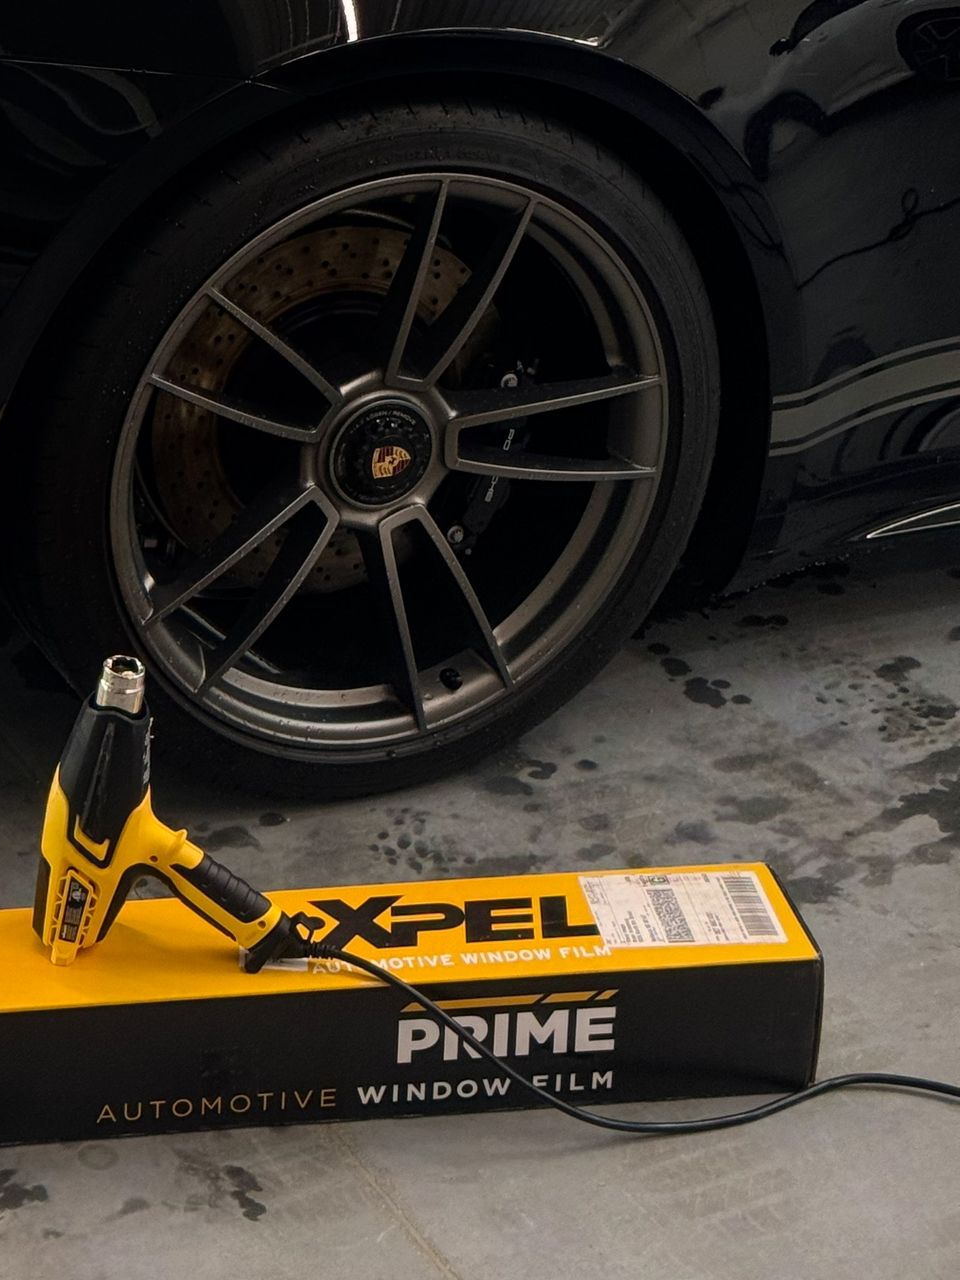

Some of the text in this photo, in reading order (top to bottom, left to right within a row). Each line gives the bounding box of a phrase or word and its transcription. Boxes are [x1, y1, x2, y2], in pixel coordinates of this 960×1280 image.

[307, 895, 601, 951] XPEL
[312, 945, 613, 974] AUTMOTIVE WINDOW FILM
[396, 1006, 617, 1064] PRIME
[96, 1070, 613, 1124] AUTOMOTIVE WINDOW FILM
